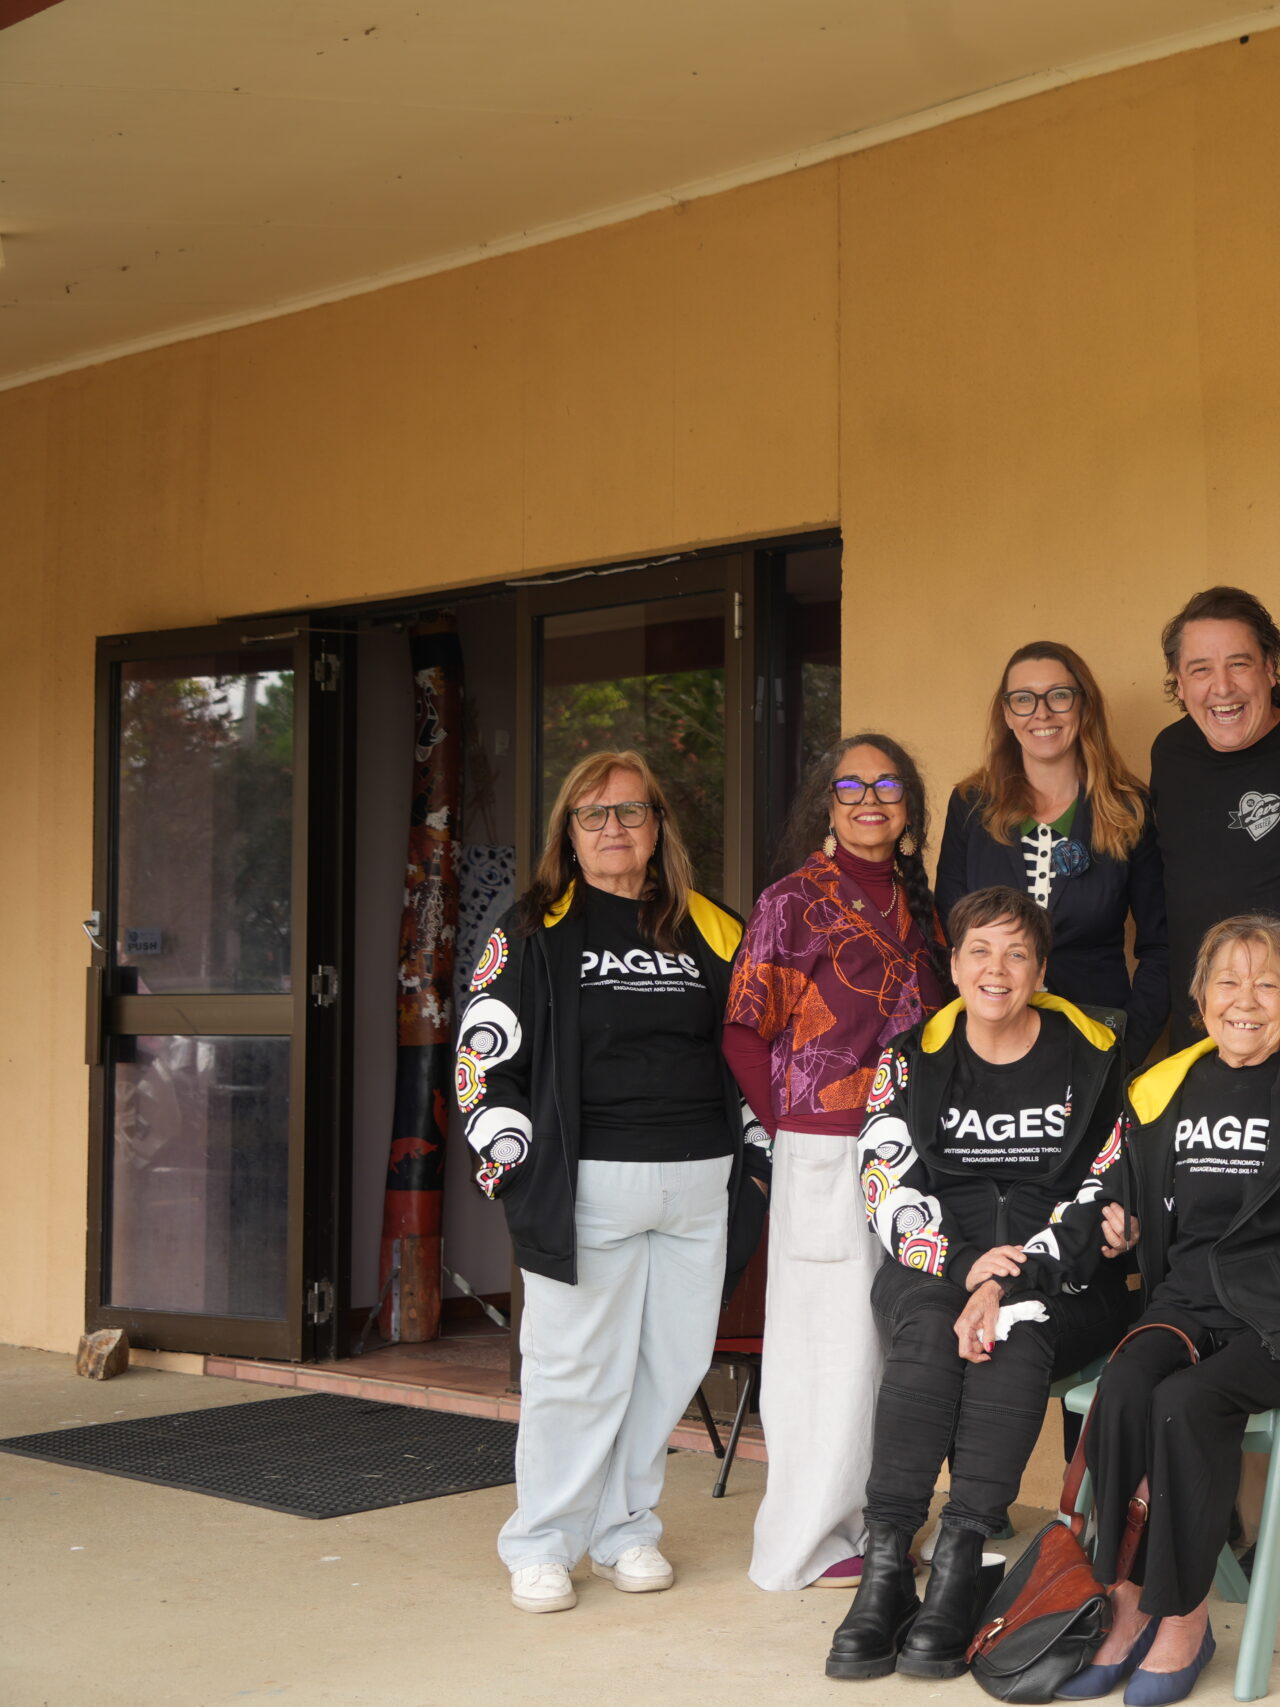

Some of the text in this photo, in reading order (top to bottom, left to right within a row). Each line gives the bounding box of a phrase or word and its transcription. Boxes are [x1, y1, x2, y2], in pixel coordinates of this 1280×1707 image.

[127, 942, 158, 952] PUSH
[580, 948, 700, 979] PAGES
[1175, 1115, 1270, 1152] PAGE
